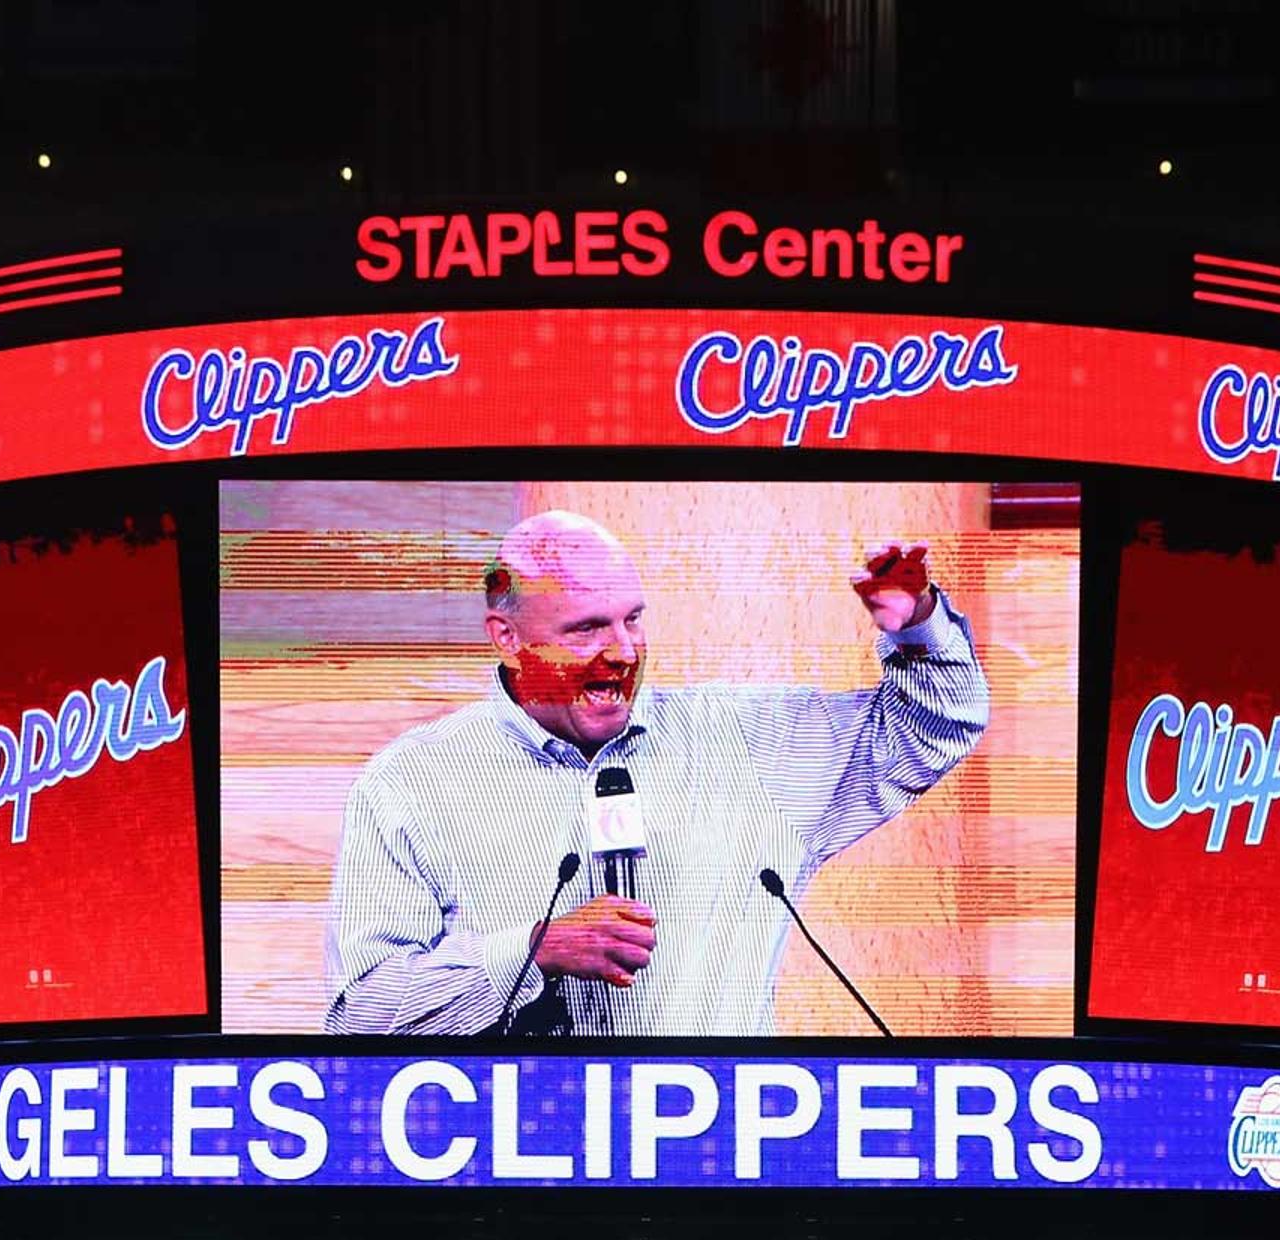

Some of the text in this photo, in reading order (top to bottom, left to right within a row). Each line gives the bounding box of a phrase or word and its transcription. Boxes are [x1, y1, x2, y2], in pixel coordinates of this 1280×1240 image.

[357, 209, 962, 283] STAPLES Center
[142, 317, 461, 456] Clippers
[675, 325, 1018, 446] Clippers
[380, 1060, 1103, 1183] CLIPPERS
